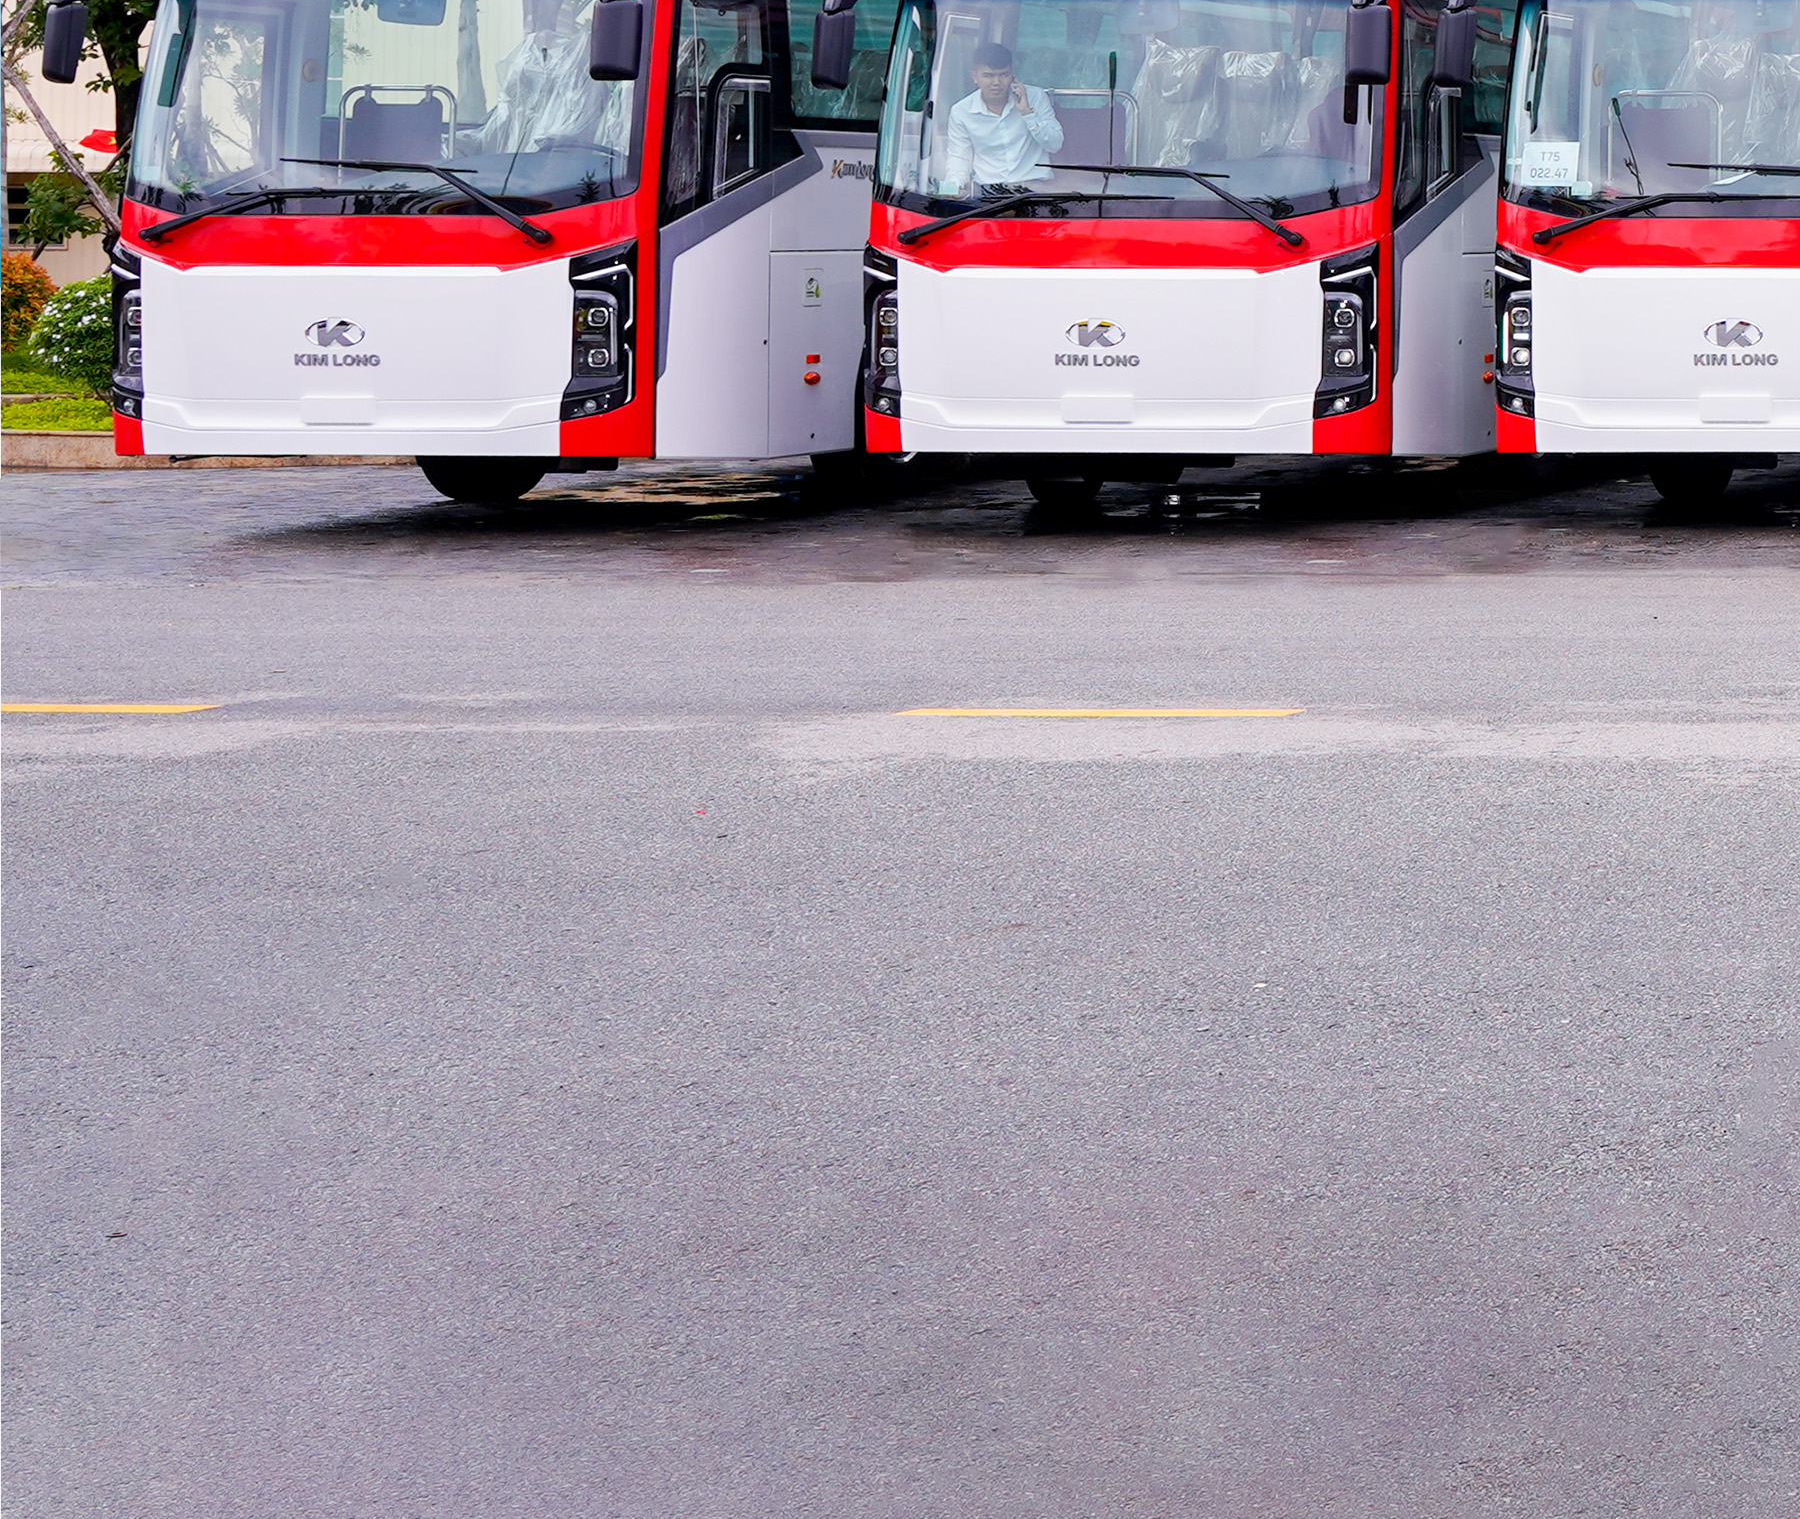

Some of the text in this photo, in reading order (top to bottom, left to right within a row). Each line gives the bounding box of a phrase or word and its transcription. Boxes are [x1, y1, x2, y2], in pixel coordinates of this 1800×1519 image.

[1530, 167, 1569, 179] 022.47
[294, 353, 381, 367] KIM LONG
[1055, 353, 1140, 367] KIM LONG
[1693, 353, 1779, 366] KIM LONG
